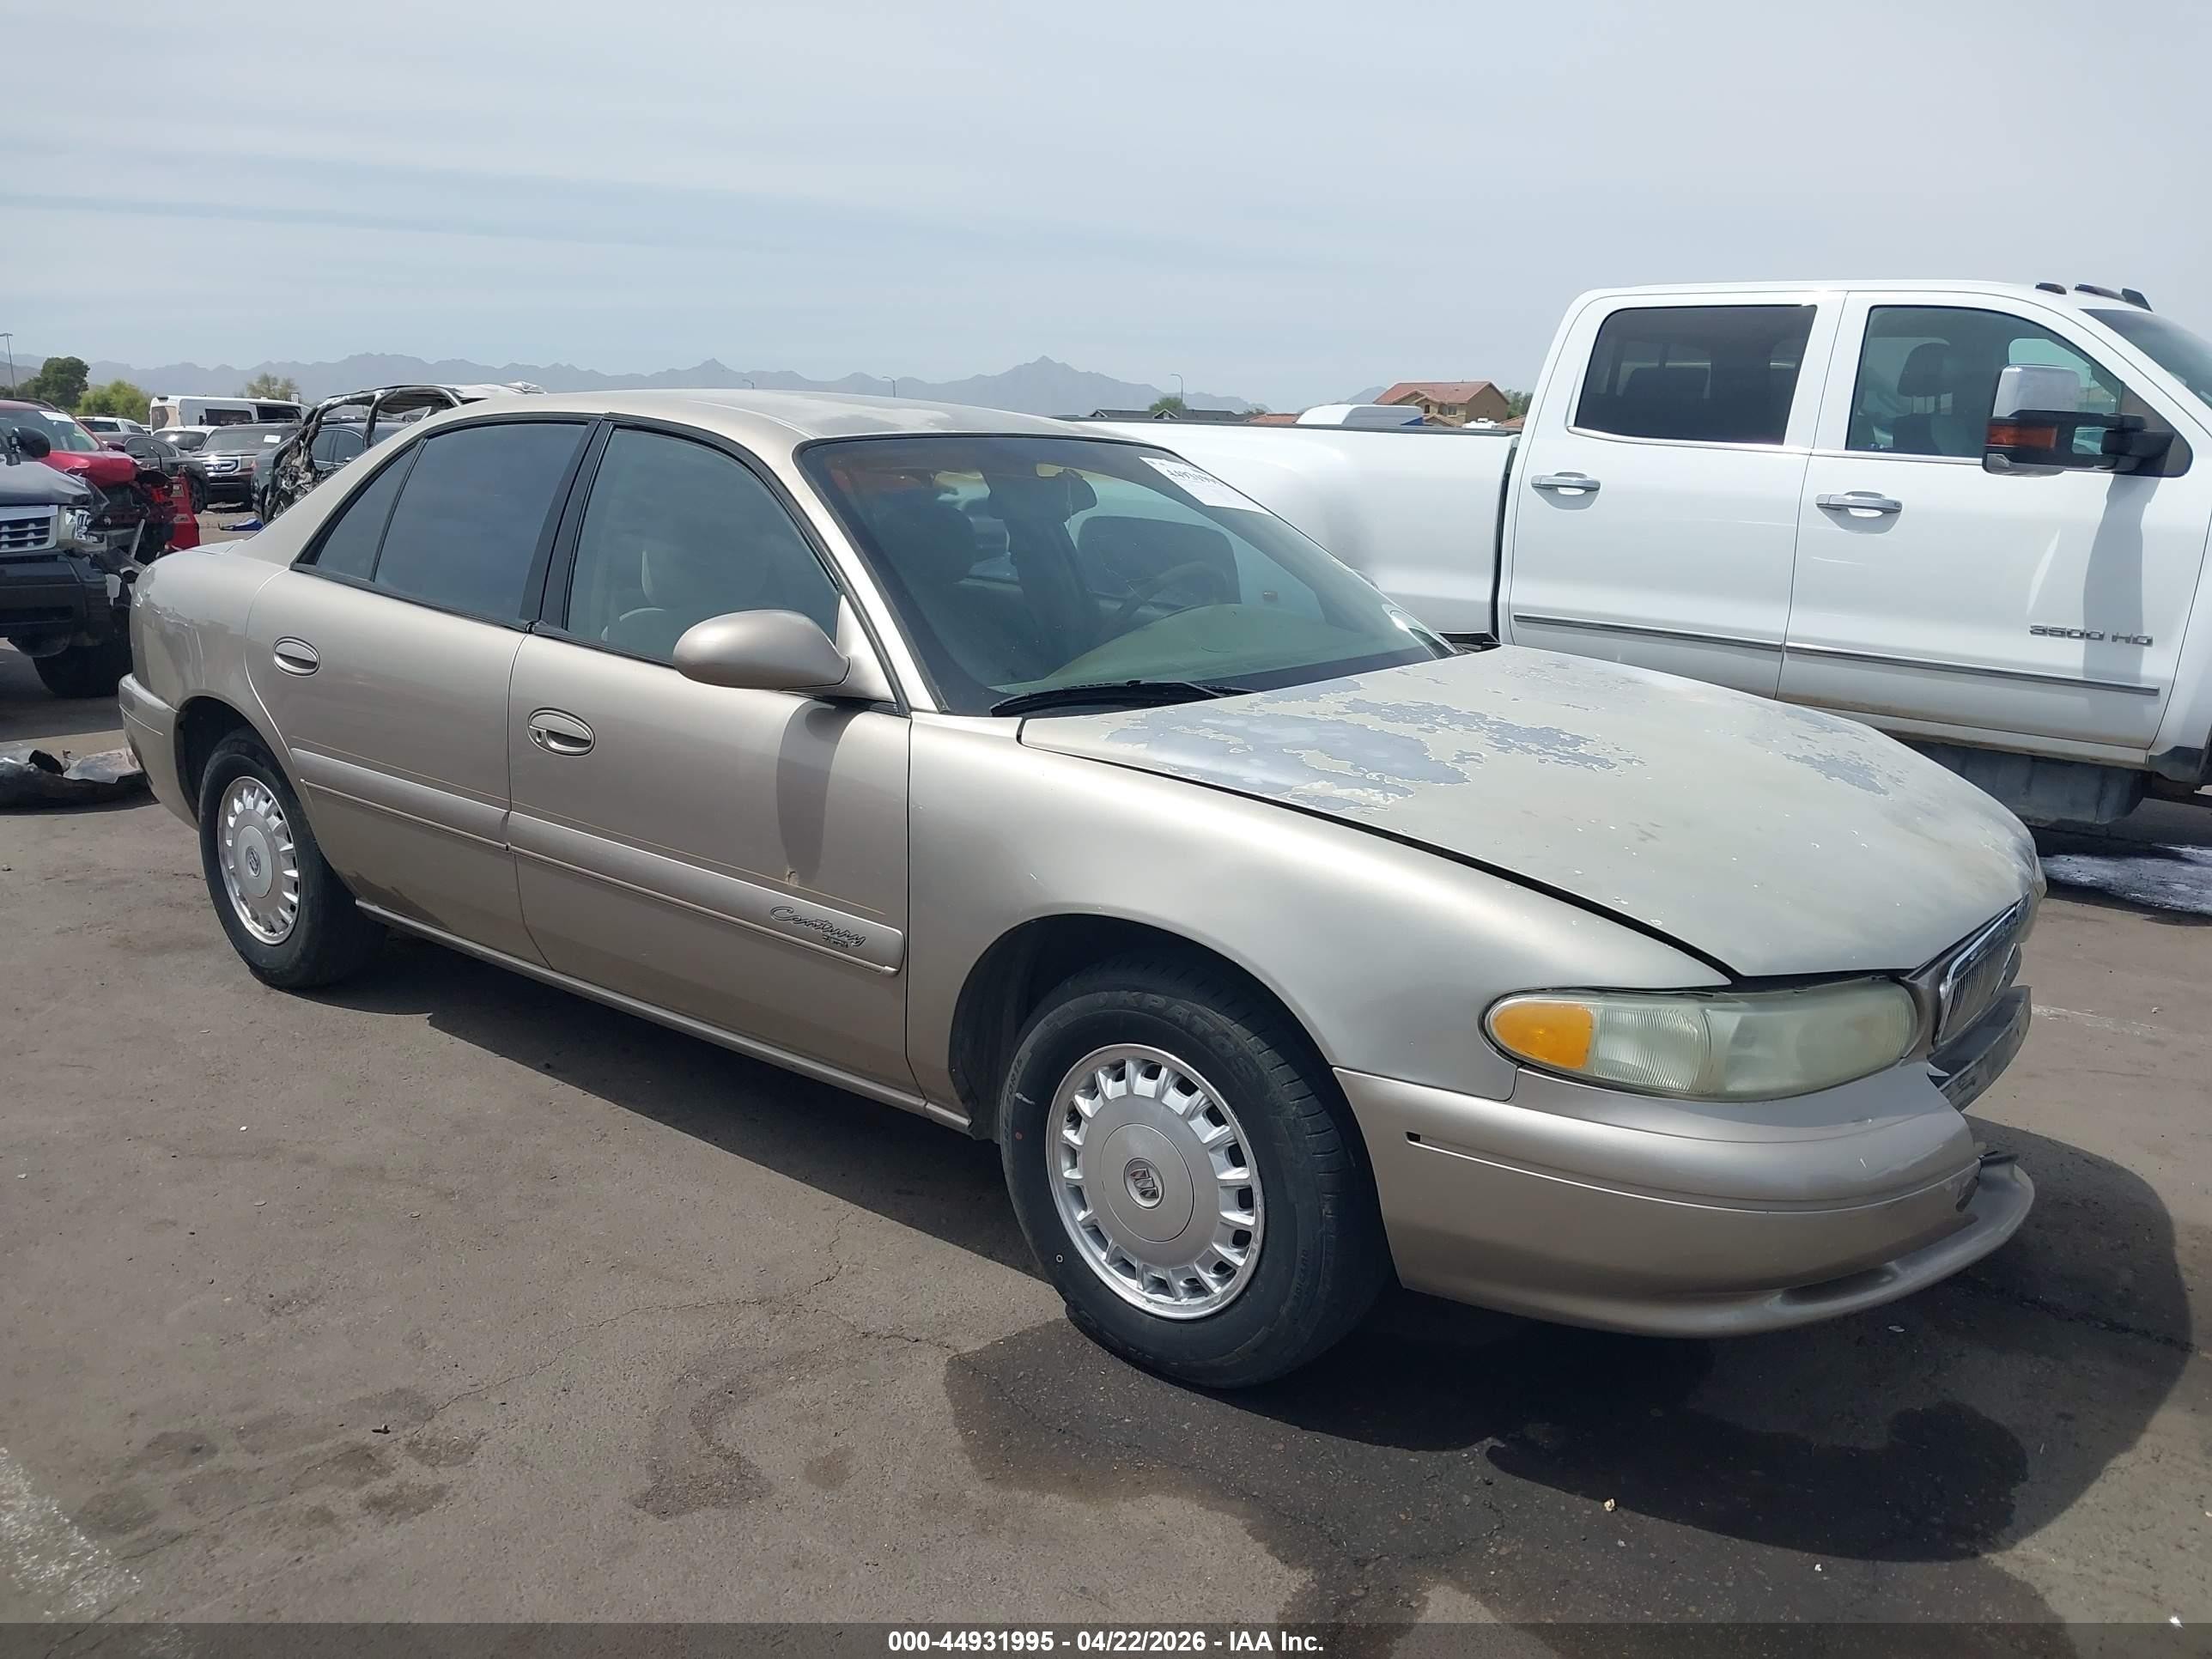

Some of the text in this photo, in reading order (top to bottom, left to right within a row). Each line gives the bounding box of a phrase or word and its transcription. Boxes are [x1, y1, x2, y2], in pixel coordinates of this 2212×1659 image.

[2030, 624, 2154, 647] 3500 HD
[769, 905, 866, 947] Century
